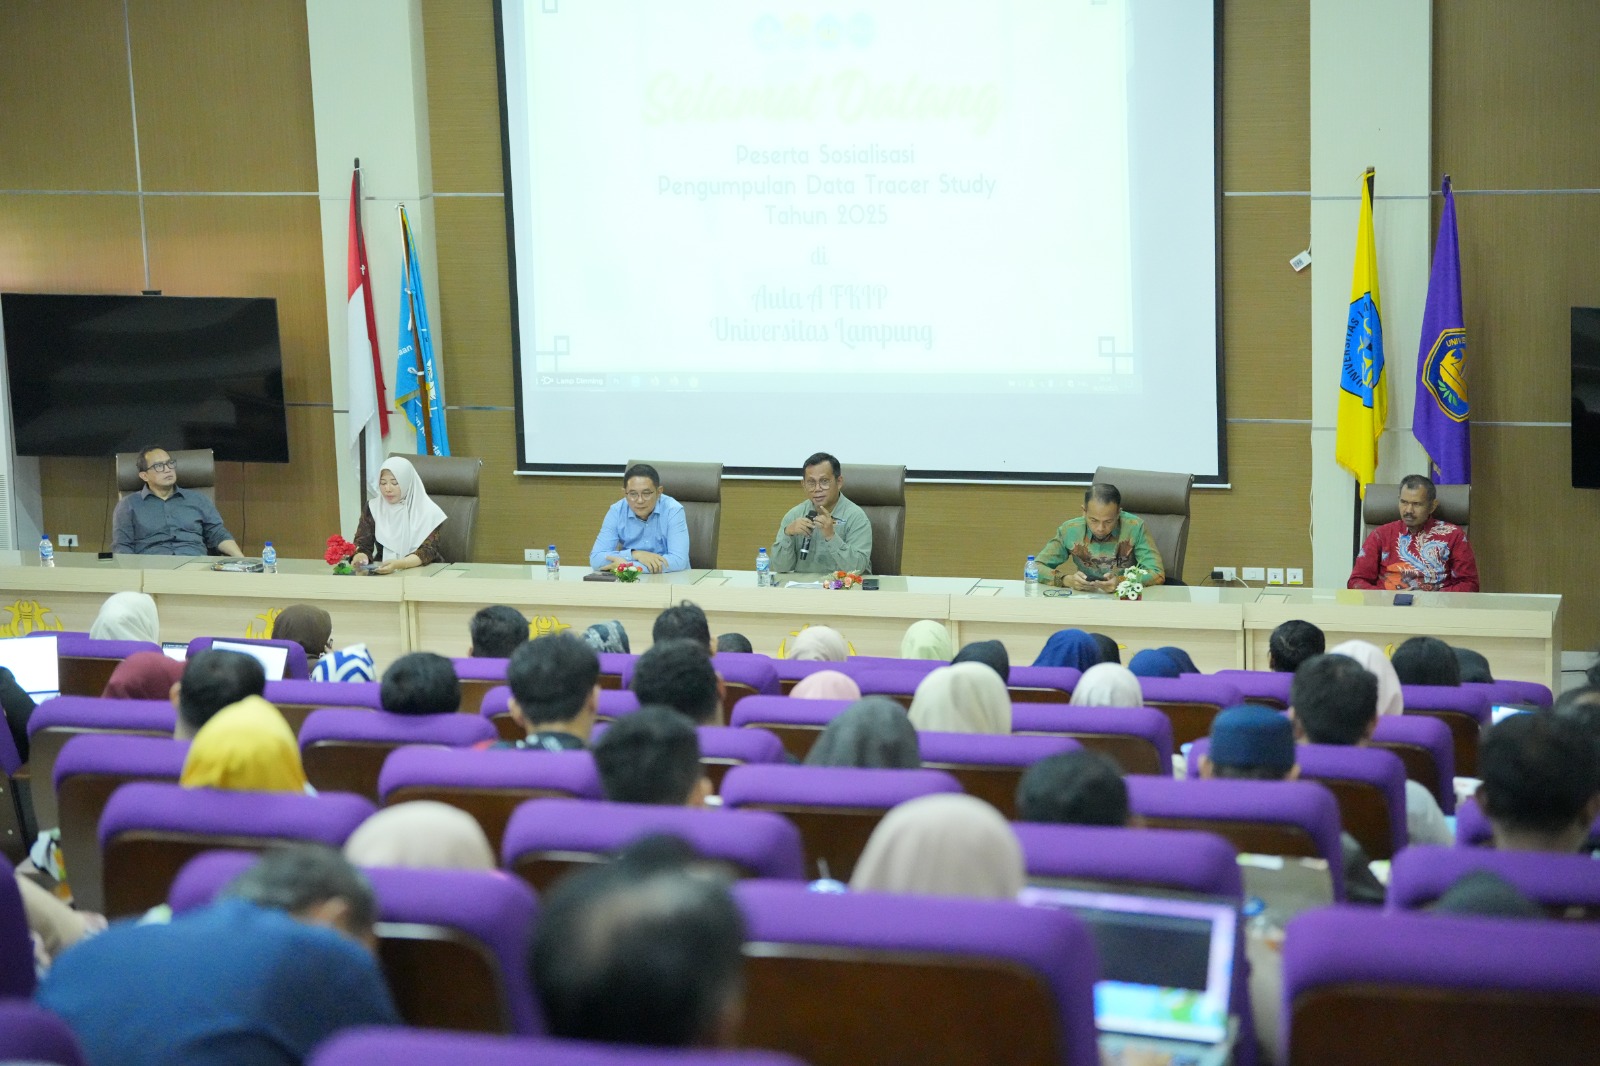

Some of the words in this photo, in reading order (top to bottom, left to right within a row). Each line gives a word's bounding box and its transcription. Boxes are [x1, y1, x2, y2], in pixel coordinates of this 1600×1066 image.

[736, 145, 810, 165] Peserta
[819, 144, 915, 165] Sosialisasi
[658, 175, 797, 201] Pengumpulan
[807, 175, 855, 196] Data
[865, 174, 930, 196] Tracer
[939, 174, 996, 200] Study
[765, 205, 828, 226] Tahun
[837, 206, 889, 226] 2025
[810, 245, 830, 267] di
[751, 284, 804, 312] Aula
[830, 283, 889, 311] FKIP
[710, 318, 830, 345] Universitas
[835, 317, 935, 351] Lampung
